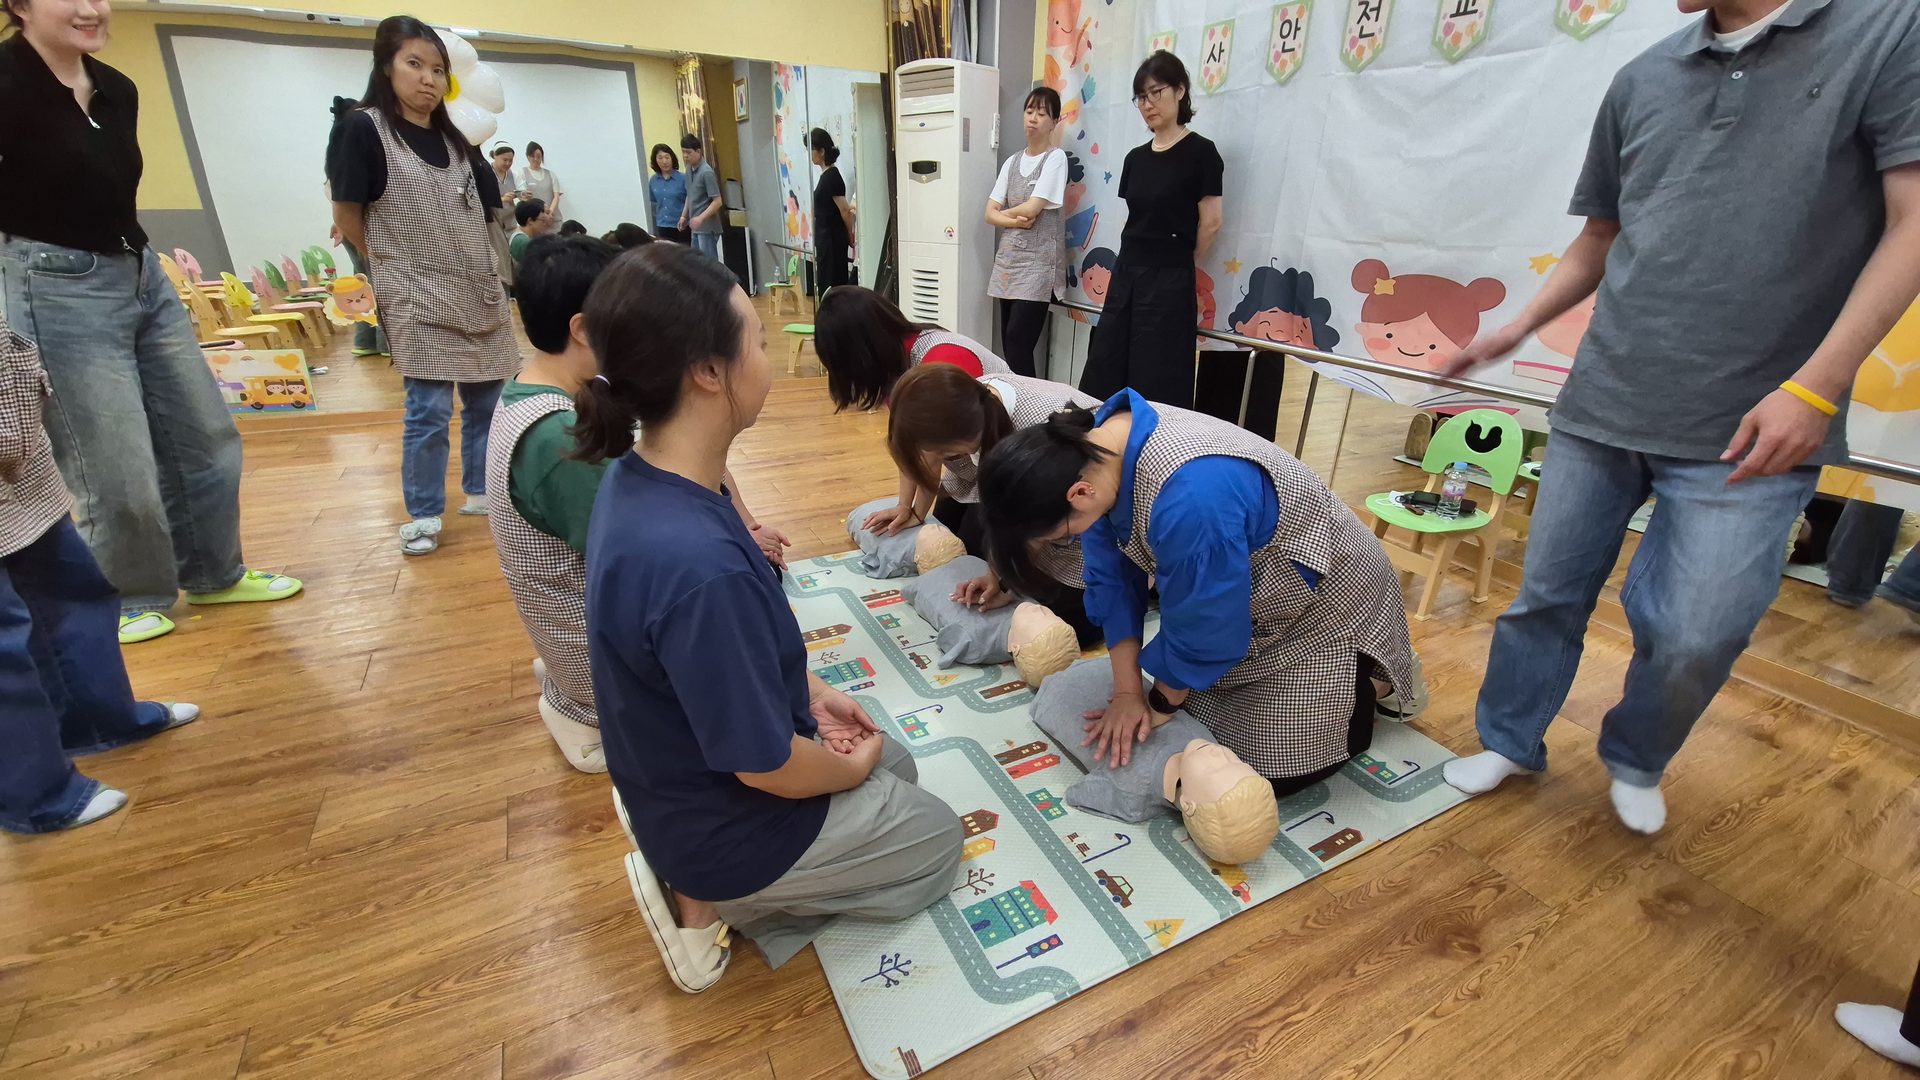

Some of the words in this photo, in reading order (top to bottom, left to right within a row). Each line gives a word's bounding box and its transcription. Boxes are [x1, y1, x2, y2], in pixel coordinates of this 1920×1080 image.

[1206, 41, 1225, 64] 사
[1279, 17, 1301, 53] 안
[1356, 0, 1382, 39] 전
